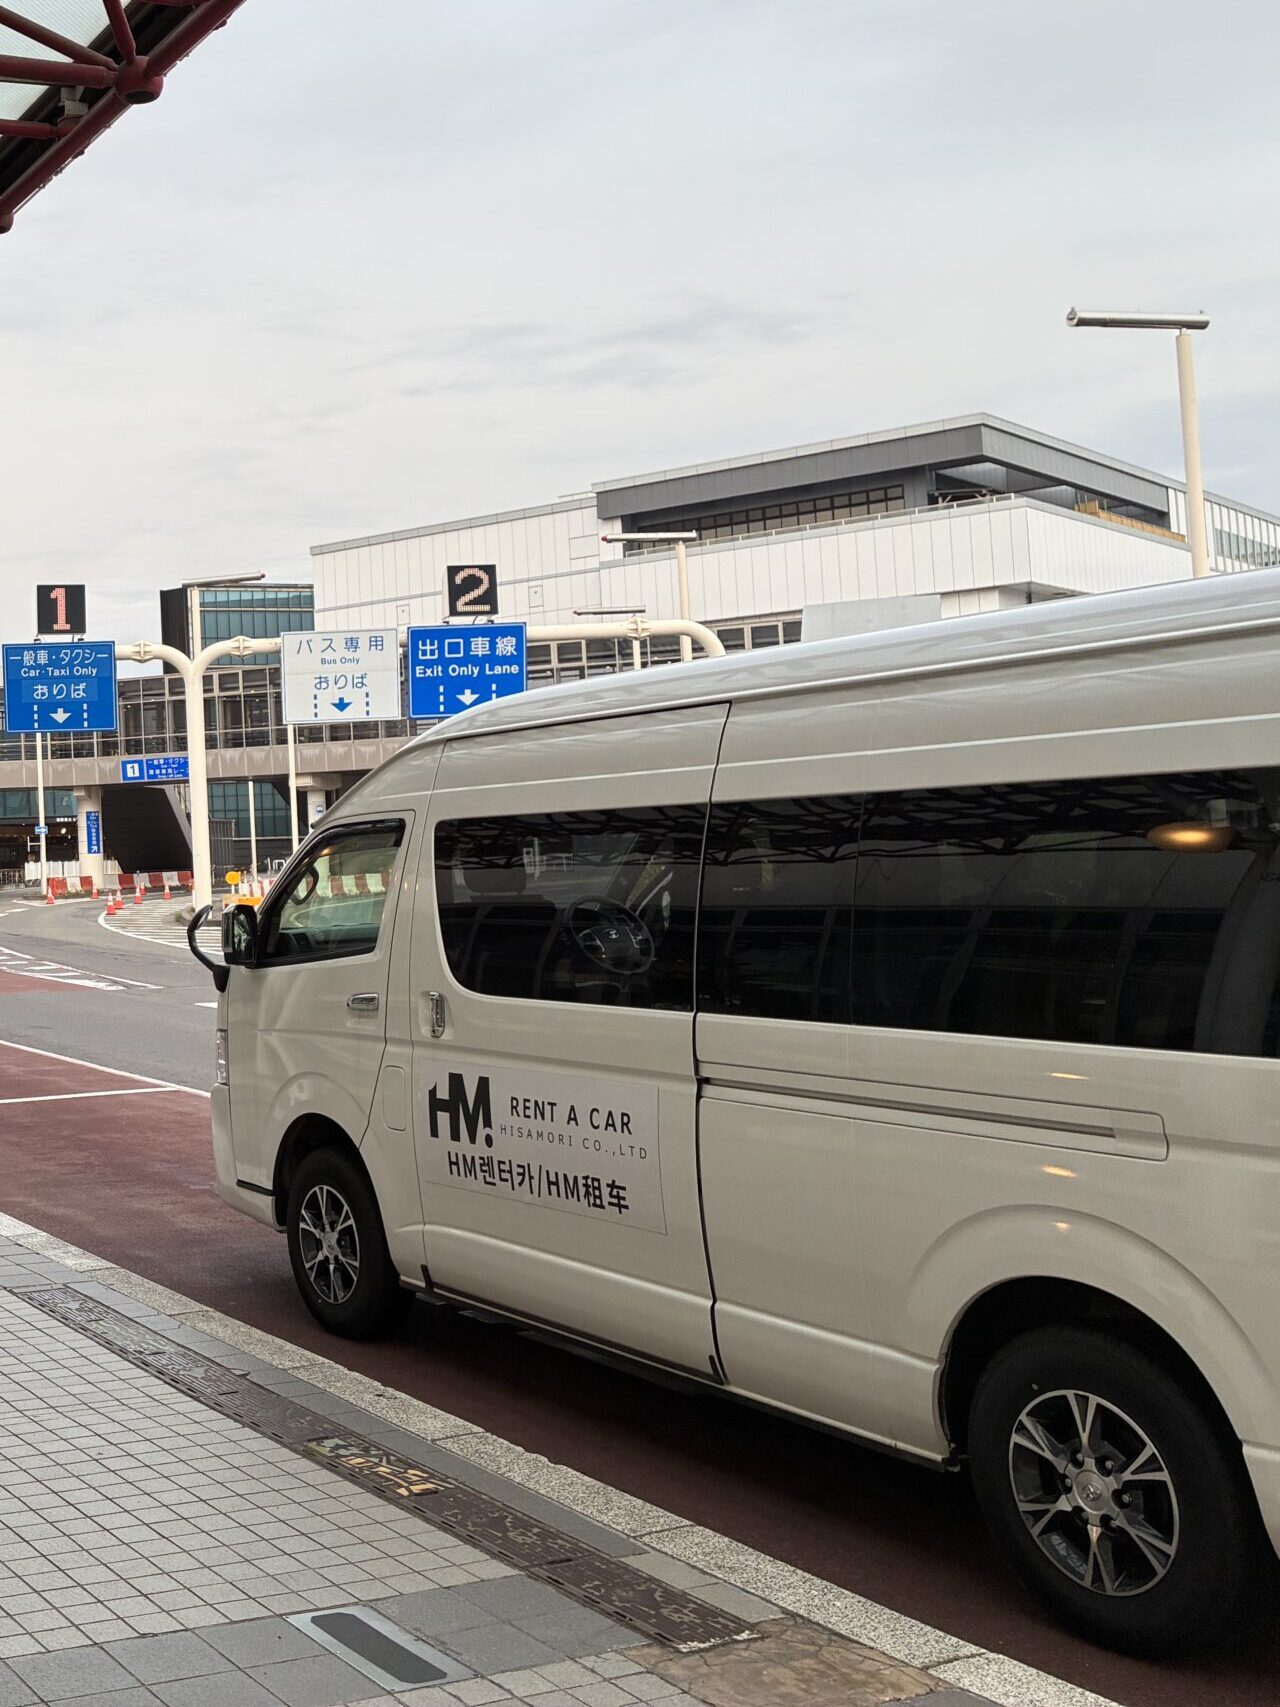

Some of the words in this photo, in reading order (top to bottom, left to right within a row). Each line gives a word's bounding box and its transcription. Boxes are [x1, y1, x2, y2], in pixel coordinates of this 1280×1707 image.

[455, 567, 491, 612] 2
[50, 587, 71, 631] 1
[296, 635, 385, 655] バス専用
[418, 635, 518, 660] 出口車線
[9, 649, 109, 666] 一般車・タクシー
[320, 657, 337, 665] Bus
[340, 656, 360, 665] Only
[73, 666, 98, 677] Only
[415, 666, 443, 678] Exit
[448, 664, 480, 678] Only
[485, 663, 520, 675] Lane
[314, 673, 368, 690] おりば
[33, 682, 87, 700] おりば
[129, 765, 136, 776] 1
[510, 1096, 558, 1123] RENT
[566, 1104, 579, 1126] A
[589, 1107, 633, 1135] CAR
[500, 1124, 573, 1147] HISAMORI
